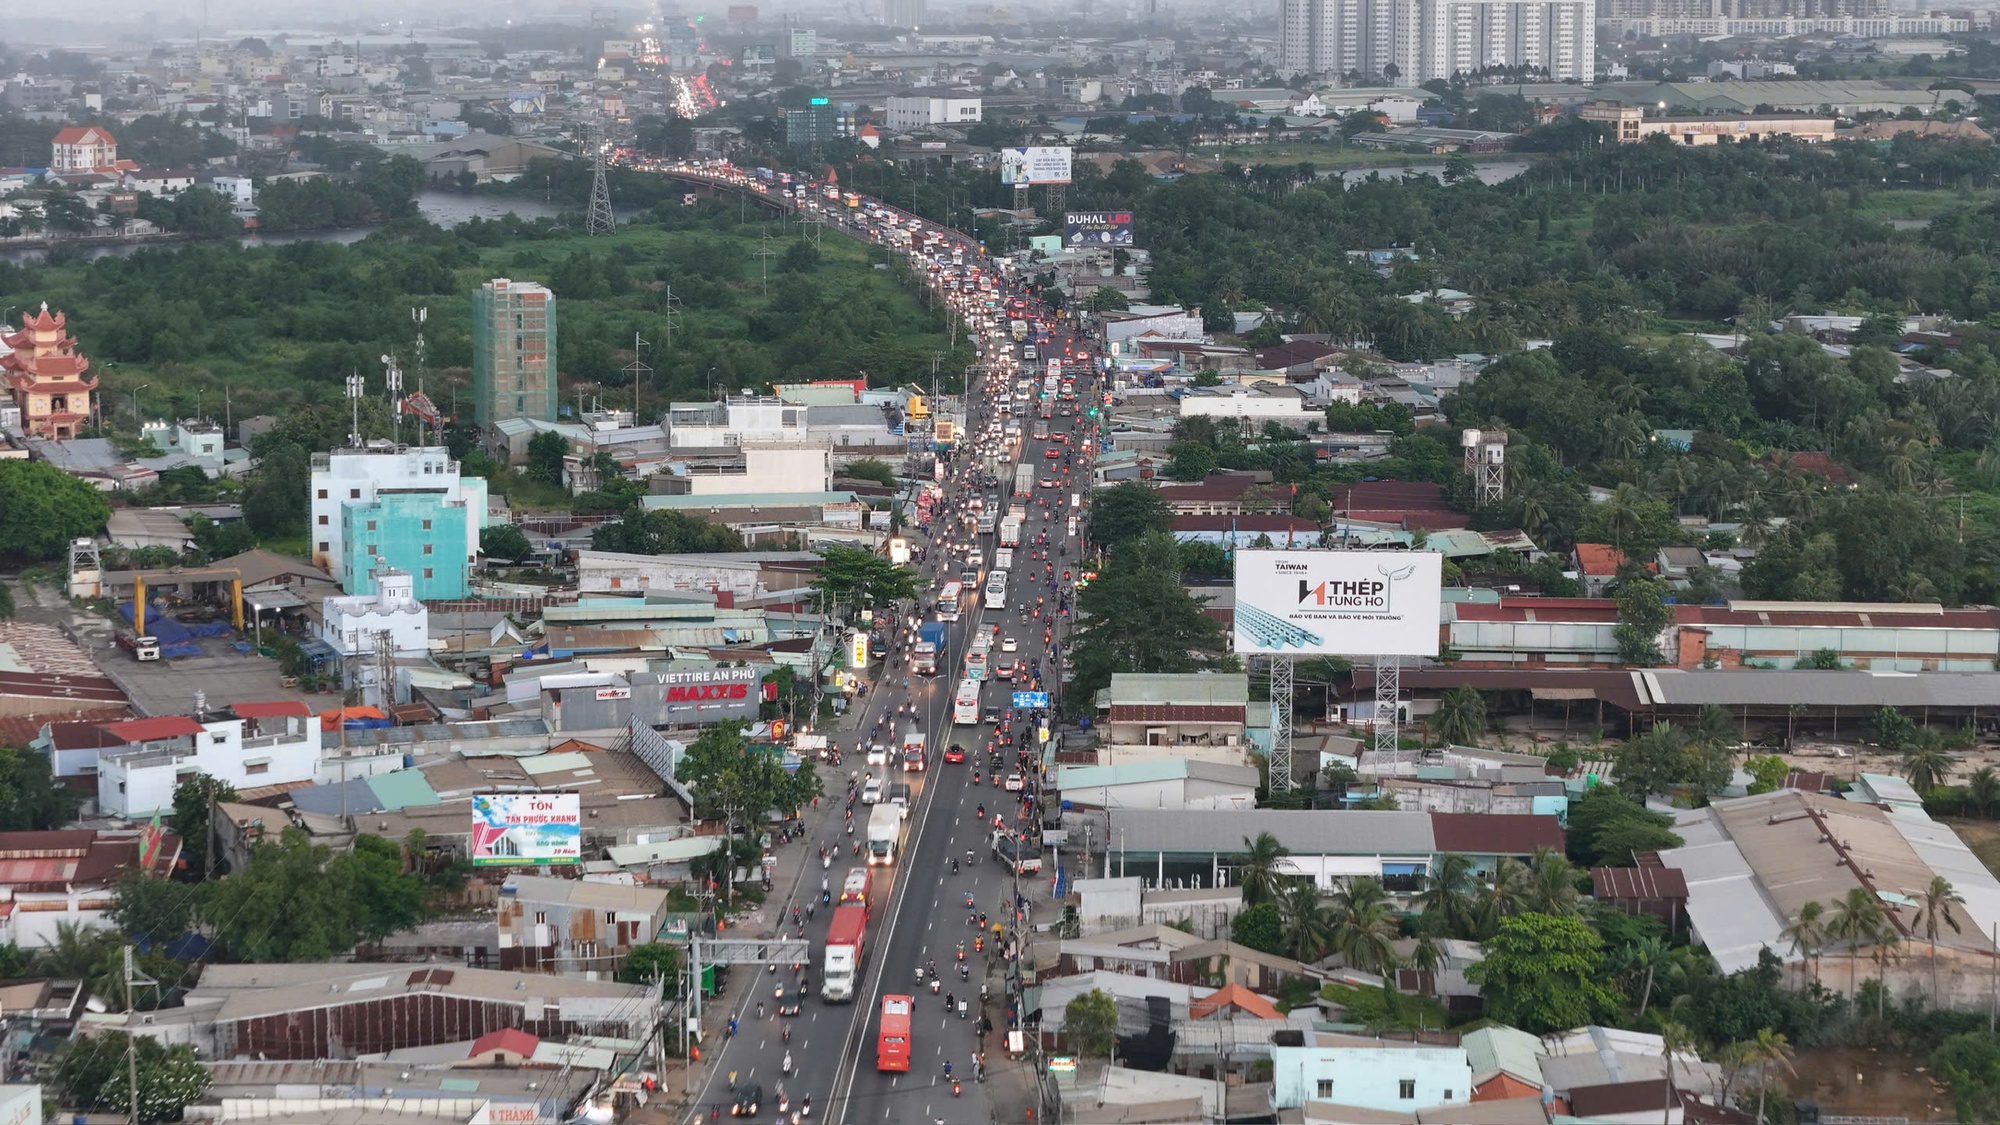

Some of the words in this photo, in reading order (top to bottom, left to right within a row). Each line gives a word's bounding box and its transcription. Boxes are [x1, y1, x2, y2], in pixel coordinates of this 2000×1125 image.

[1068, 214, 1106, 224] DUHAL
[1108, 213, 1131, 224] LED
[1329, 578, 1384, 596] THÉP
[1327, 596, 1362, 606] TUNG
[1365, 597, 1384, 607] HO
[712, 671, 729, 681] AN
[732, 667, 755, 680] PHÚ
[666, 684, 748, 702] MAXXIS
[529, 800, 553, 811] TÔN
